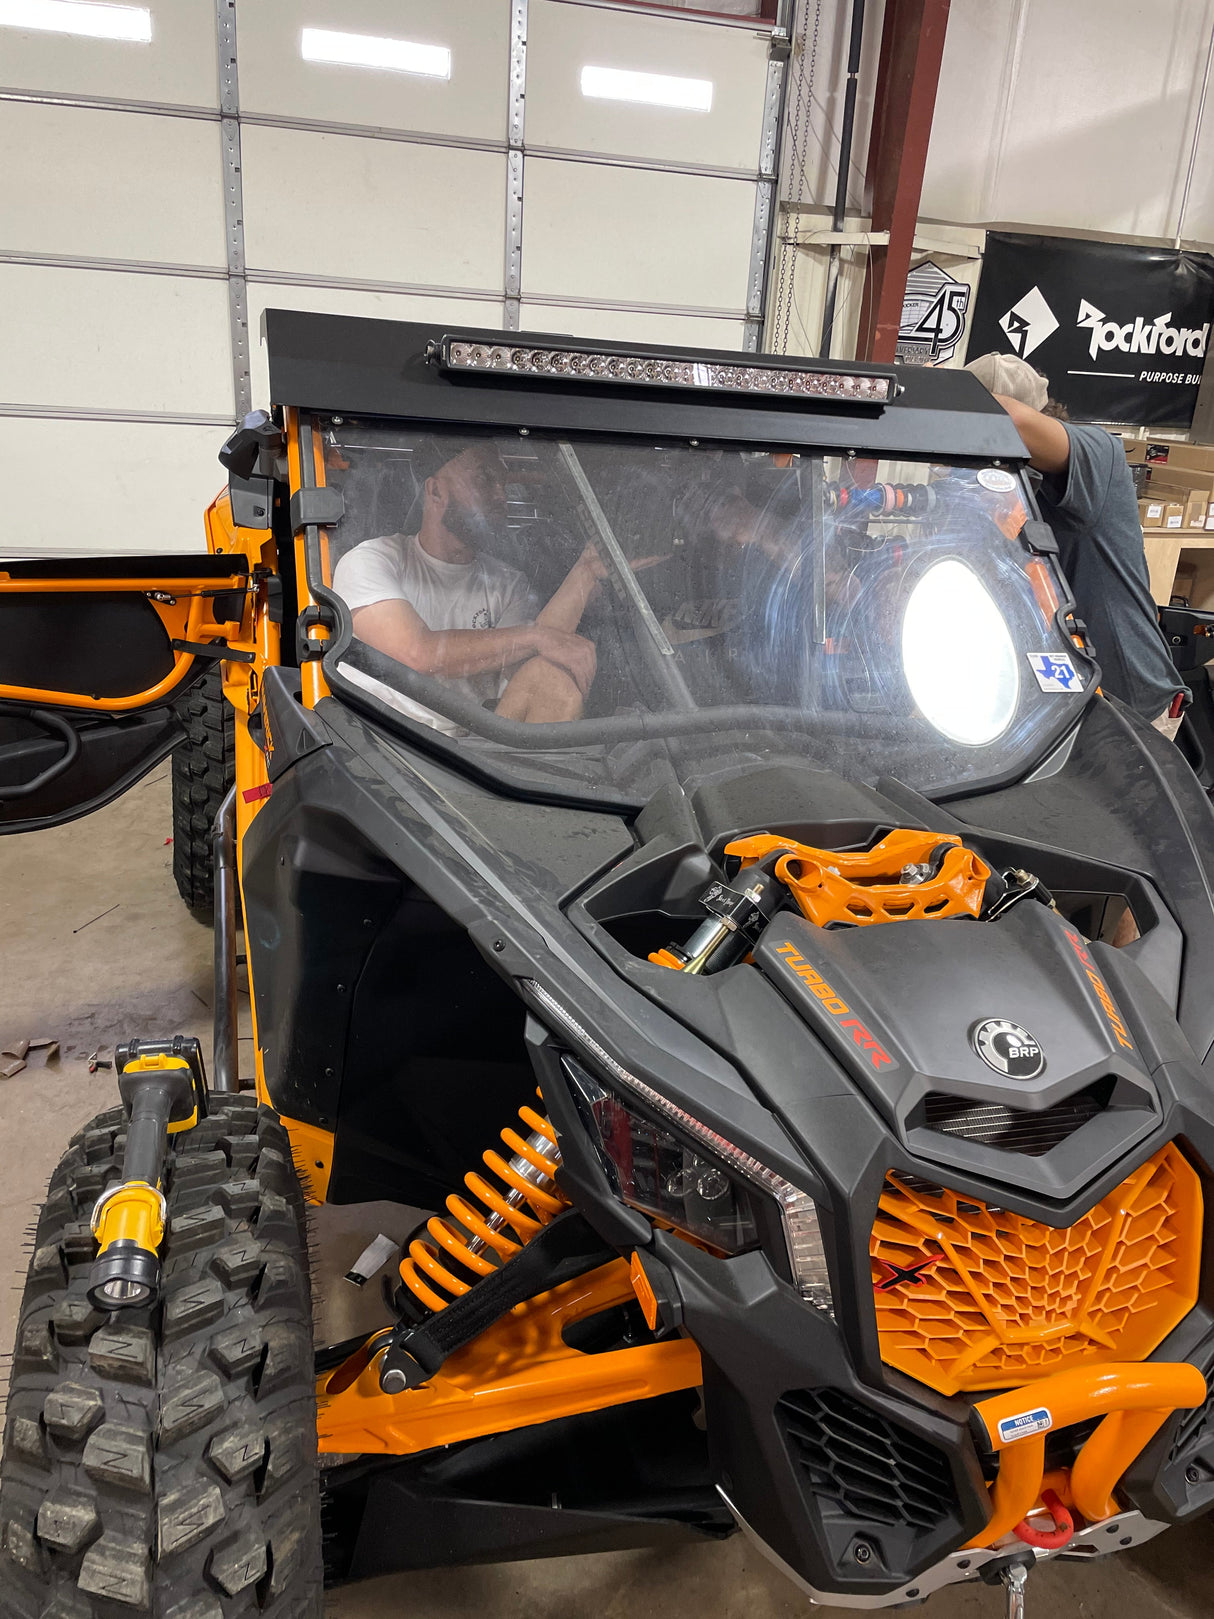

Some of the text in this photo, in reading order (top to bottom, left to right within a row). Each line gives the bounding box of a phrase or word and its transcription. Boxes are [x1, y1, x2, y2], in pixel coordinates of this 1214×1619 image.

[1076, 298, 1210, 361] Rockford
[1139, 371, 1184, 384] PURPOSE
[1051, 665, 1070, 679] 21
[775, 942, 891, 1070] TURBO RR
[1008, 1046, 1039, 1058] BRP
[1014, 1415, 1034, 1427] NOTICE
